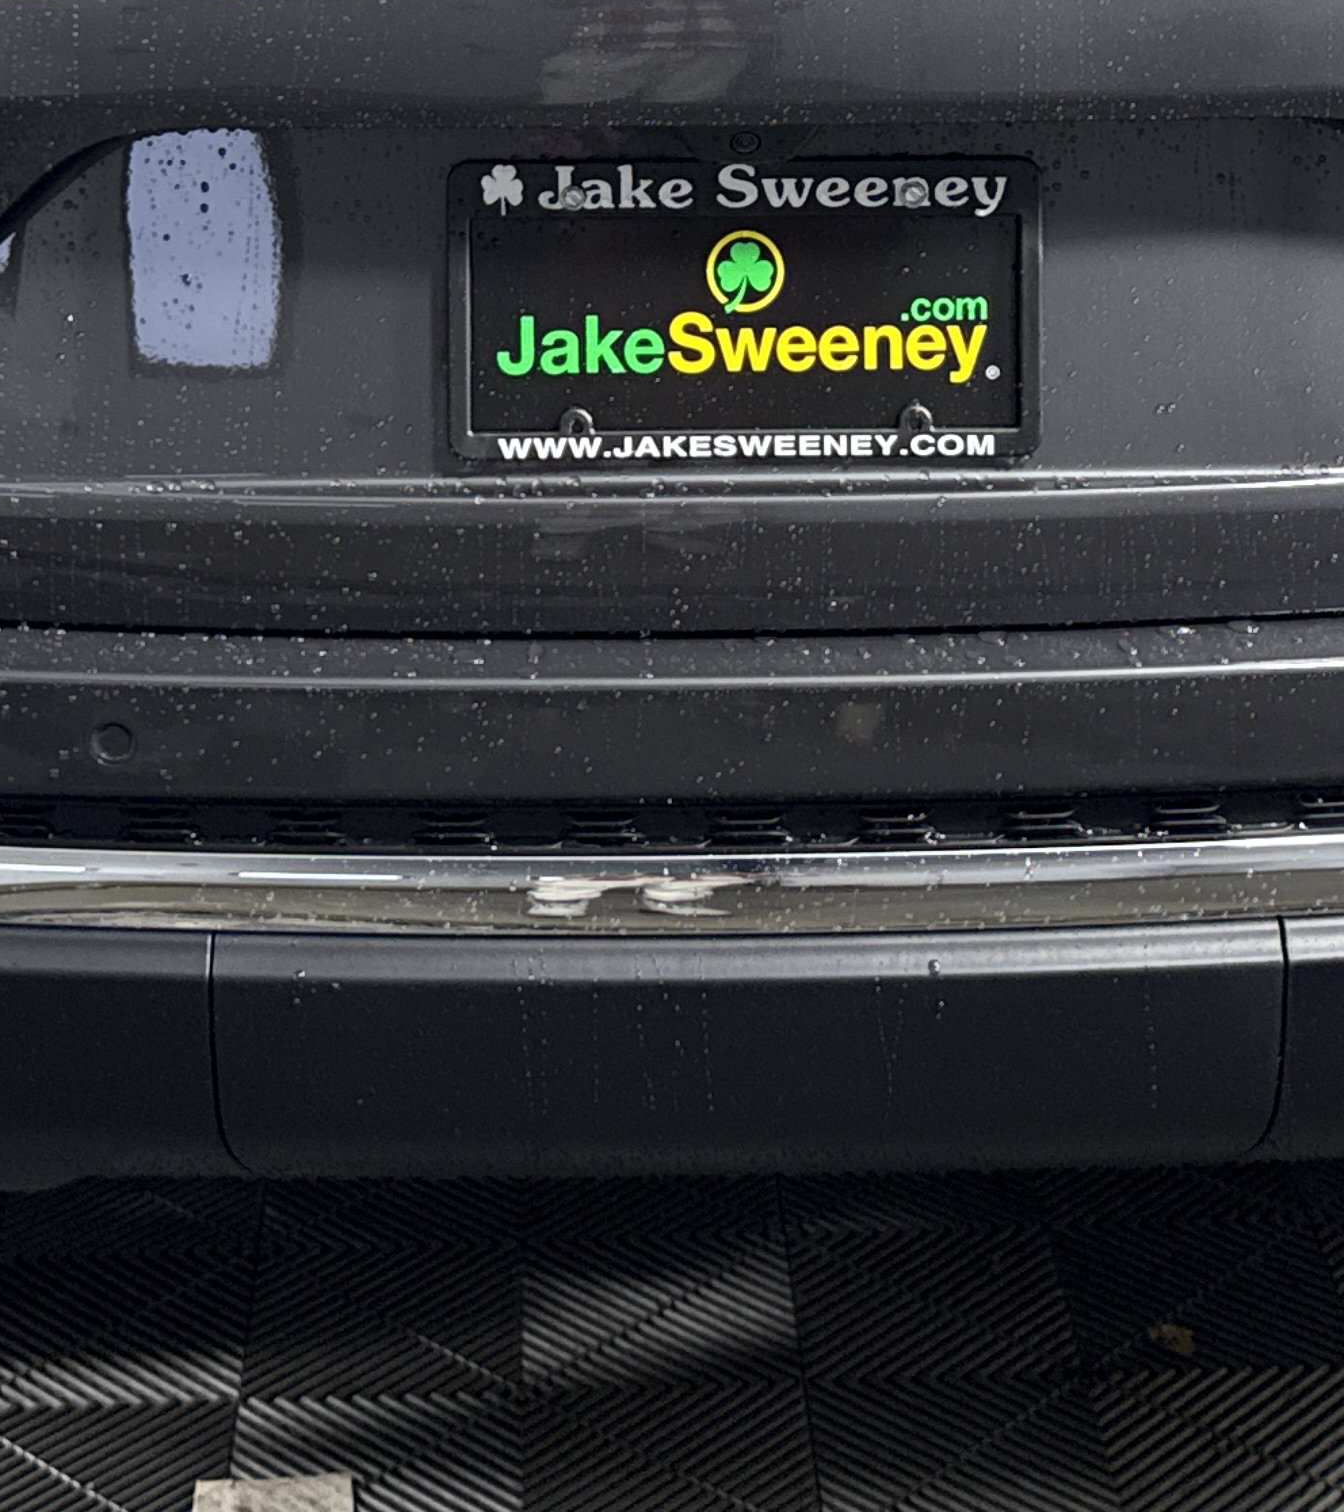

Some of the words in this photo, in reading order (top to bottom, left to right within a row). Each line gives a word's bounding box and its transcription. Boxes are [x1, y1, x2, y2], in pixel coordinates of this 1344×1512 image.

[538, 164, 693, 210] Jake
[716, 163, 1008, 217] Sweeney
[900, 295, 988, 323] .com
[496, 310, 988, 384] JakeSweeney
[498, 433, 996, 460] WWW.JAKESWEENEY.COM
